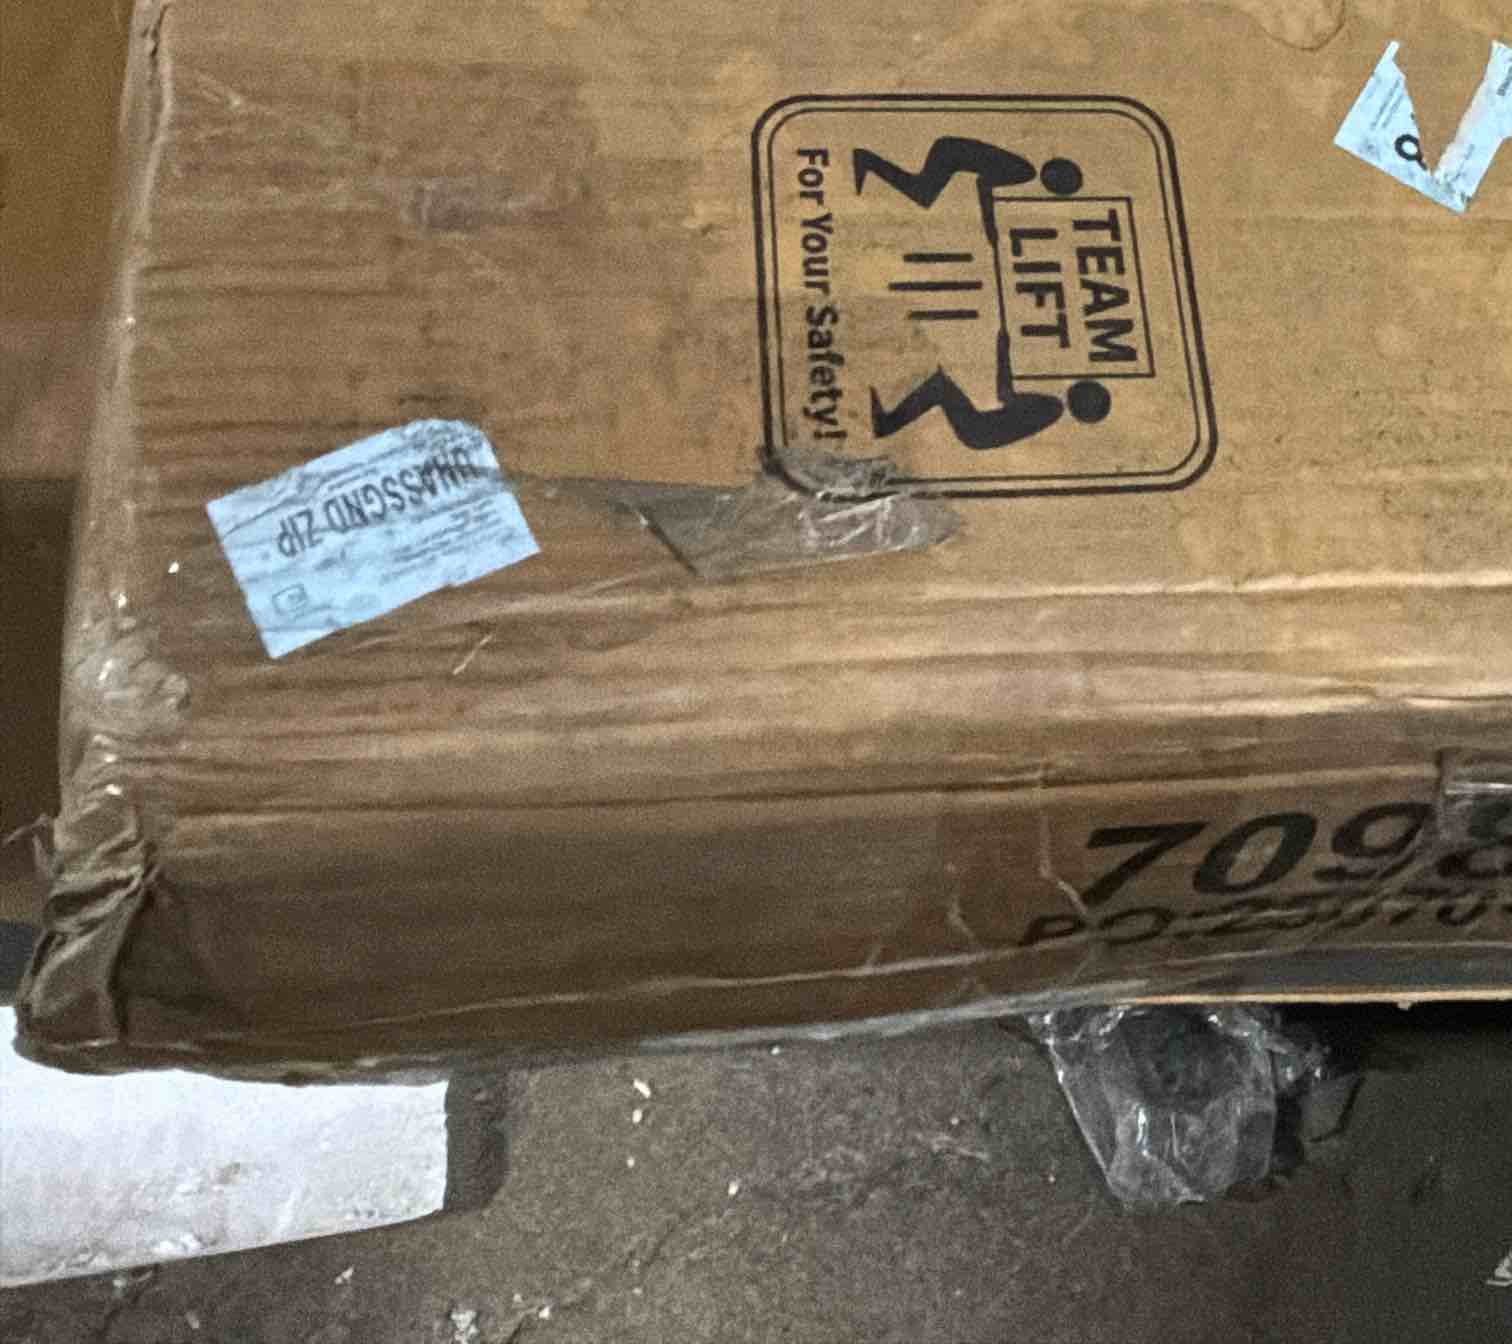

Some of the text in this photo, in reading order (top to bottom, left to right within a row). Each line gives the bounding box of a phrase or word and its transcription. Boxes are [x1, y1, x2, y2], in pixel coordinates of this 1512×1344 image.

[797, 148, 848, 441] For Your Safety!
[1009, 228, 1070, 349] LIFT
[1071, 209, 1137, 363] TEAM
[275, 508, 324, 559] ZIP
